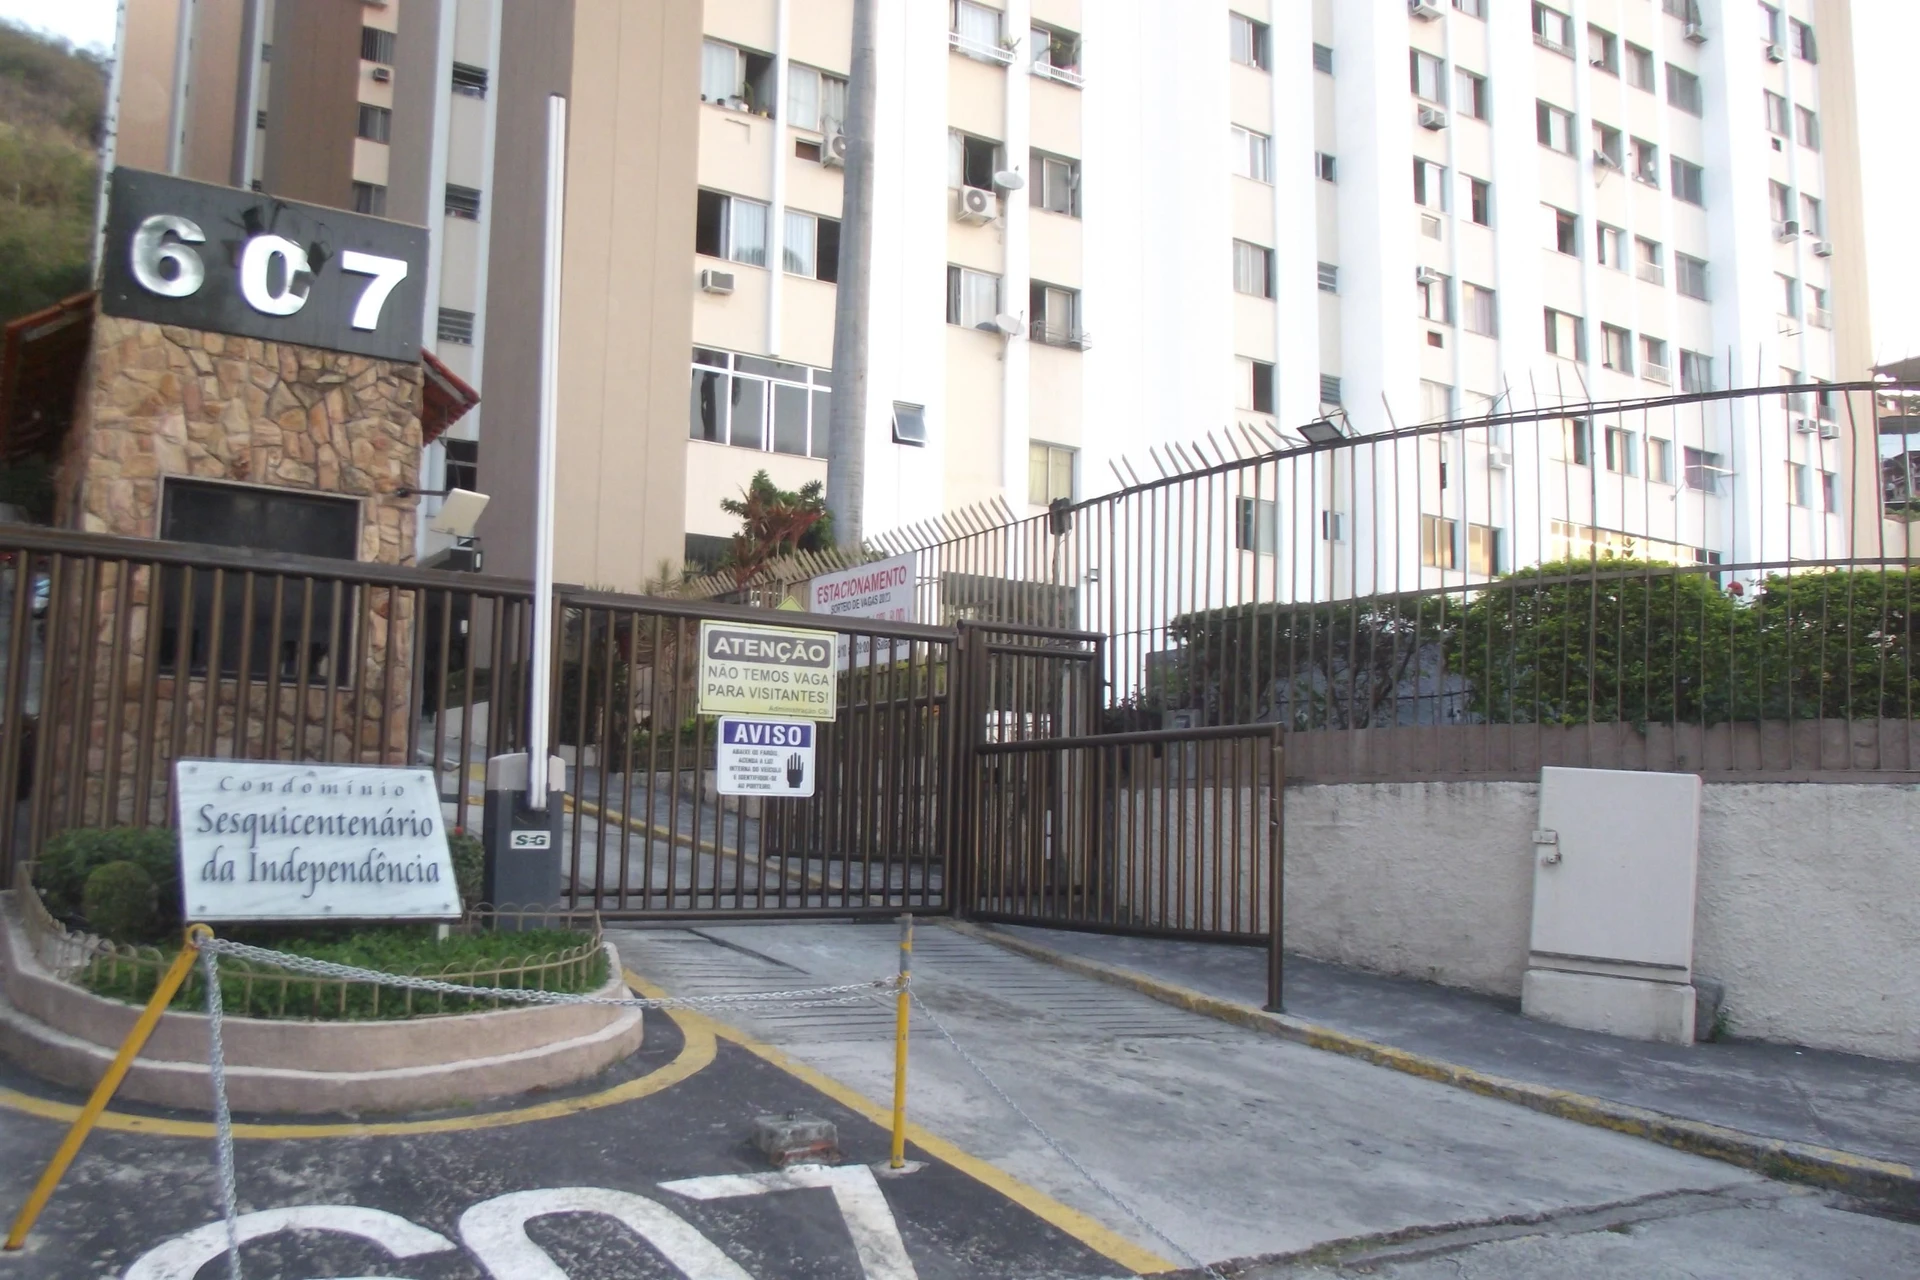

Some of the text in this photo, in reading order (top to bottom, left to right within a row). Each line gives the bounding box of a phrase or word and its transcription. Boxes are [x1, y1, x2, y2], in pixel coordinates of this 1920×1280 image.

[131, 214, 408, 331] 607
[817, 565, 907, 605] ESTACIONAMENTO
[830, 600, 851, 614] SORTEIO
[852, 599, 860, 610] DE
[861, 595, 878, 608] VAGAS
[713, 636, 826, 663] ATENÇÃO
[708, 663, 830, 686] NÃO TEMOS VAGA
[707, 683, 829, 704] PARA VISITANTES!
[734, 723, 802, 746] AVISO
[219, 774, 406, 798] Condomínio
[197, 803, 434, 848] Sesquicentenário
[202, 846, 441, 899] da Independência
